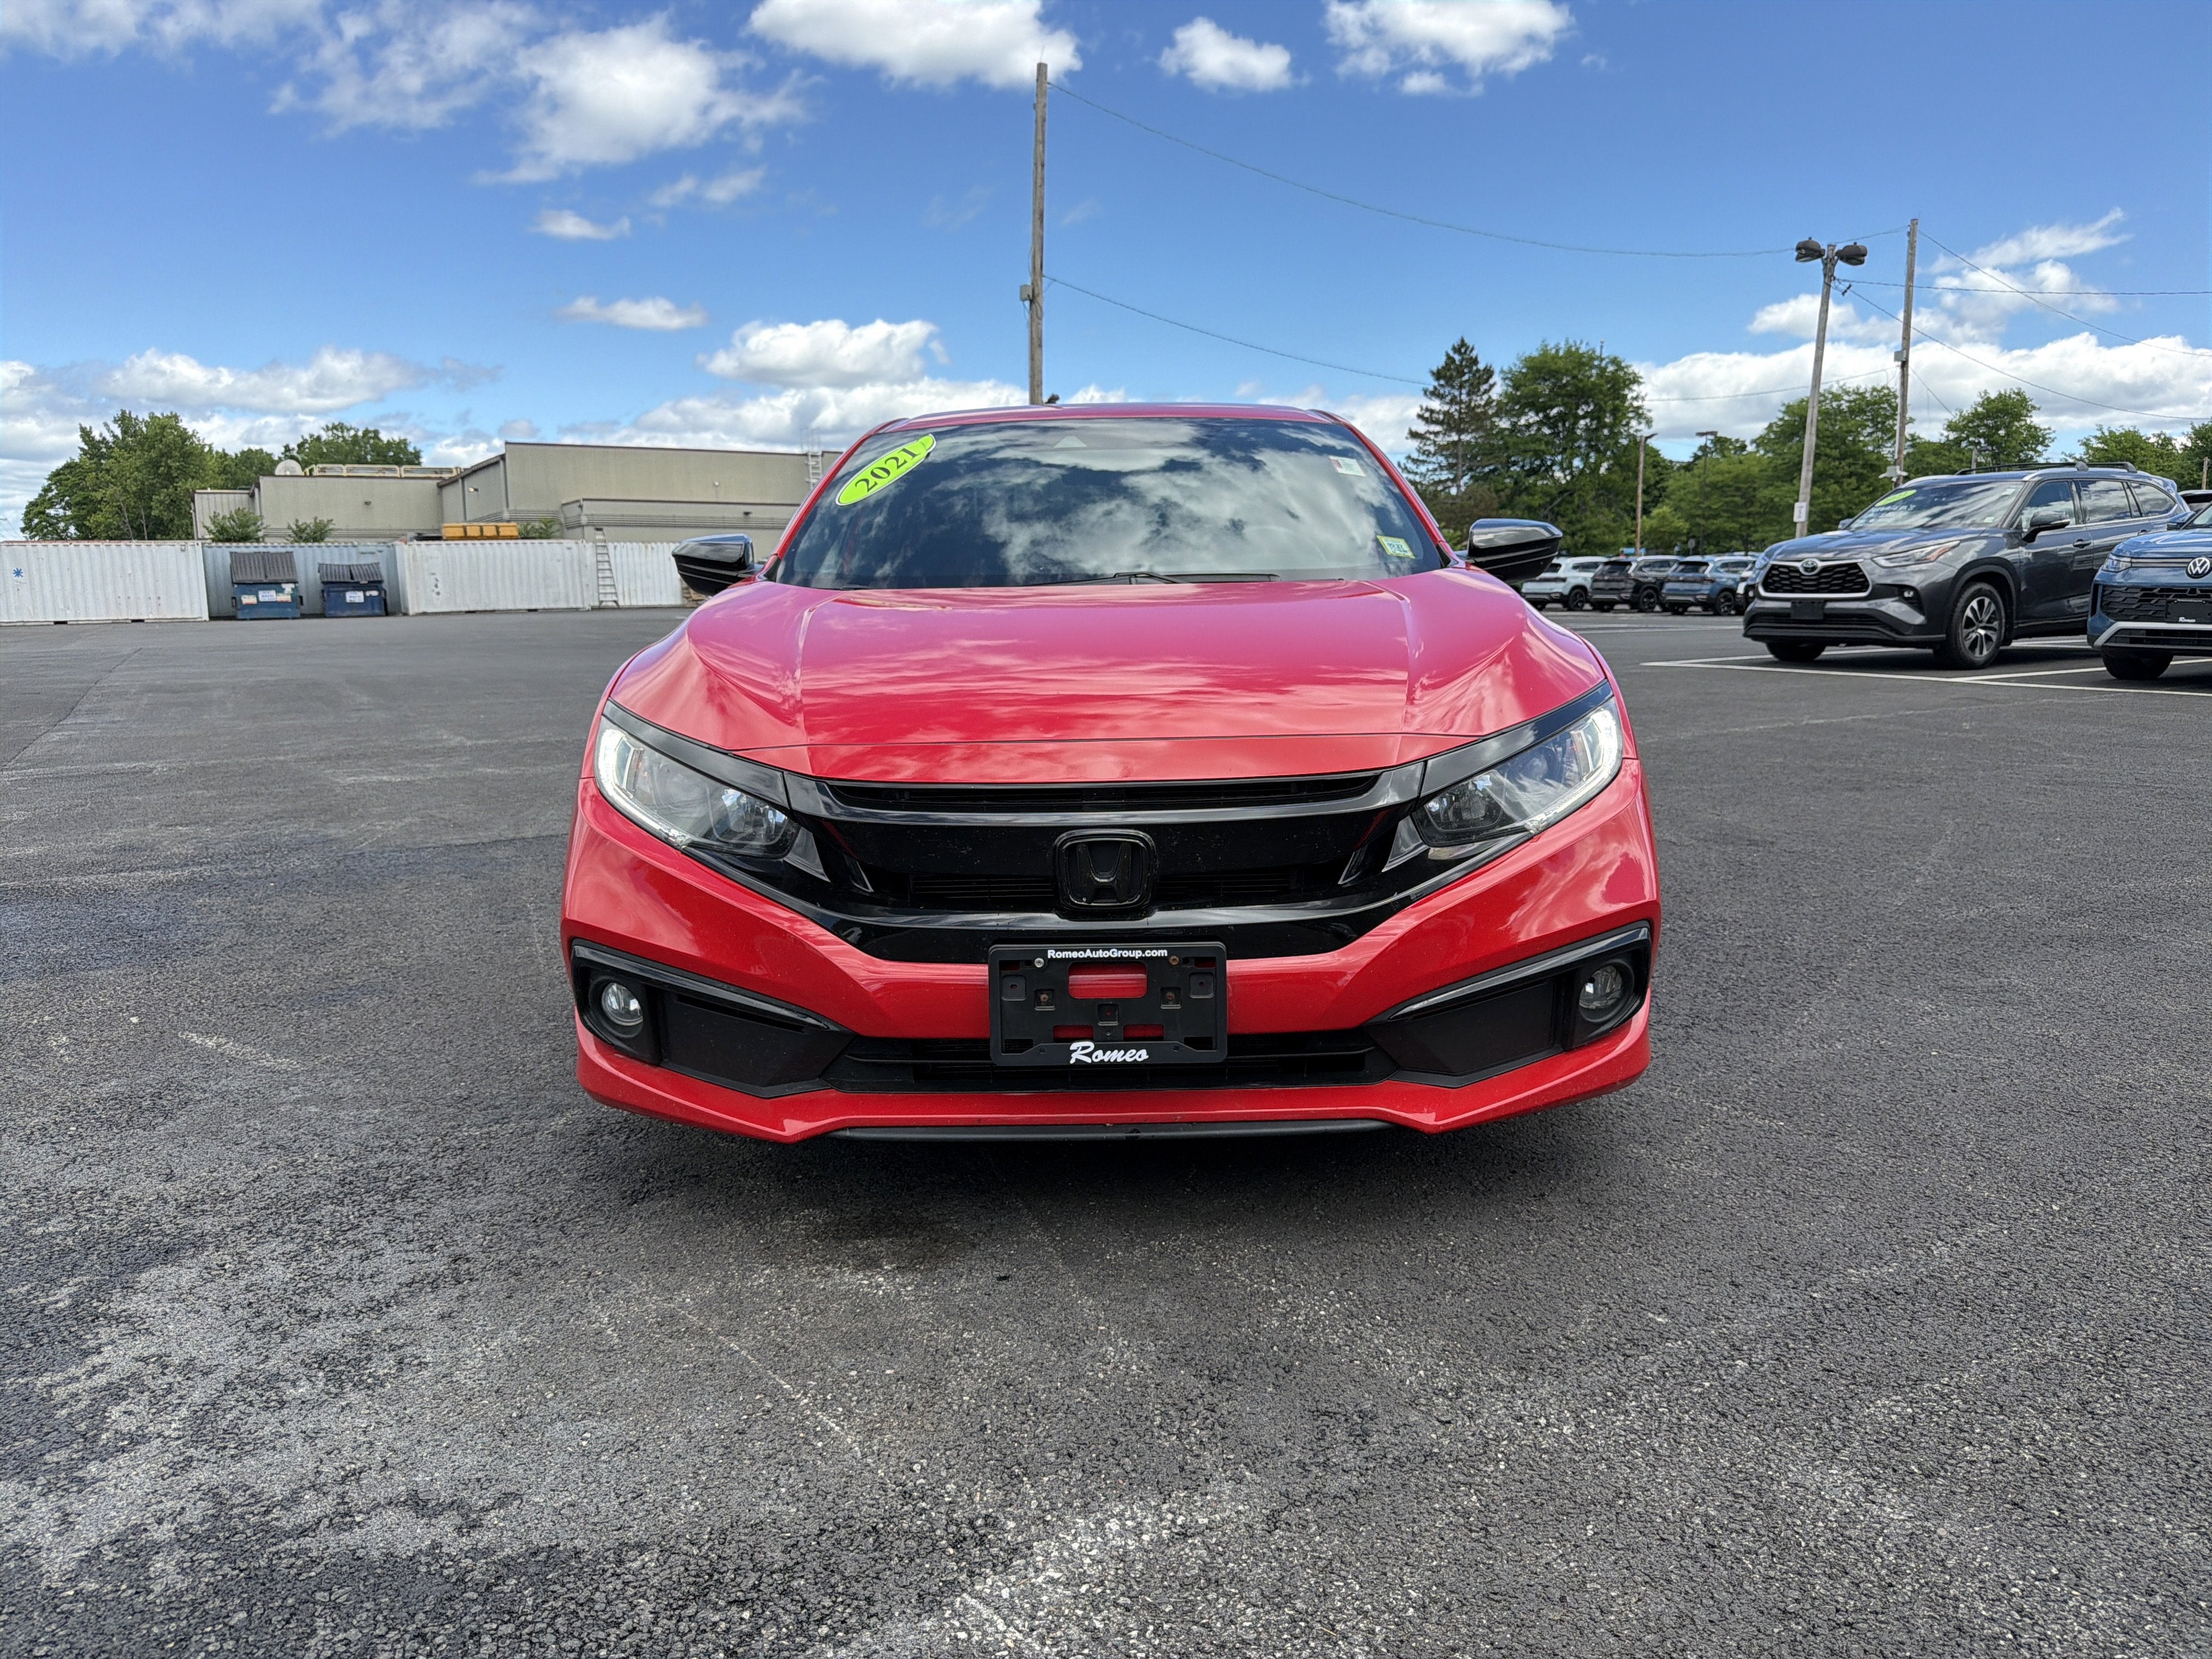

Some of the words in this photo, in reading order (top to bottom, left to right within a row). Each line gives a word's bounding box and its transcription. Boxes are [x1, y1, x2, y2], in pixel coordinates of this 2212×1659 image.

[855, 448, 921, 493] 2021
[1047, 949, 1167, 958] RomeoAutoGroup.com
[1070, 1041, 1149, 1064] Romeo
